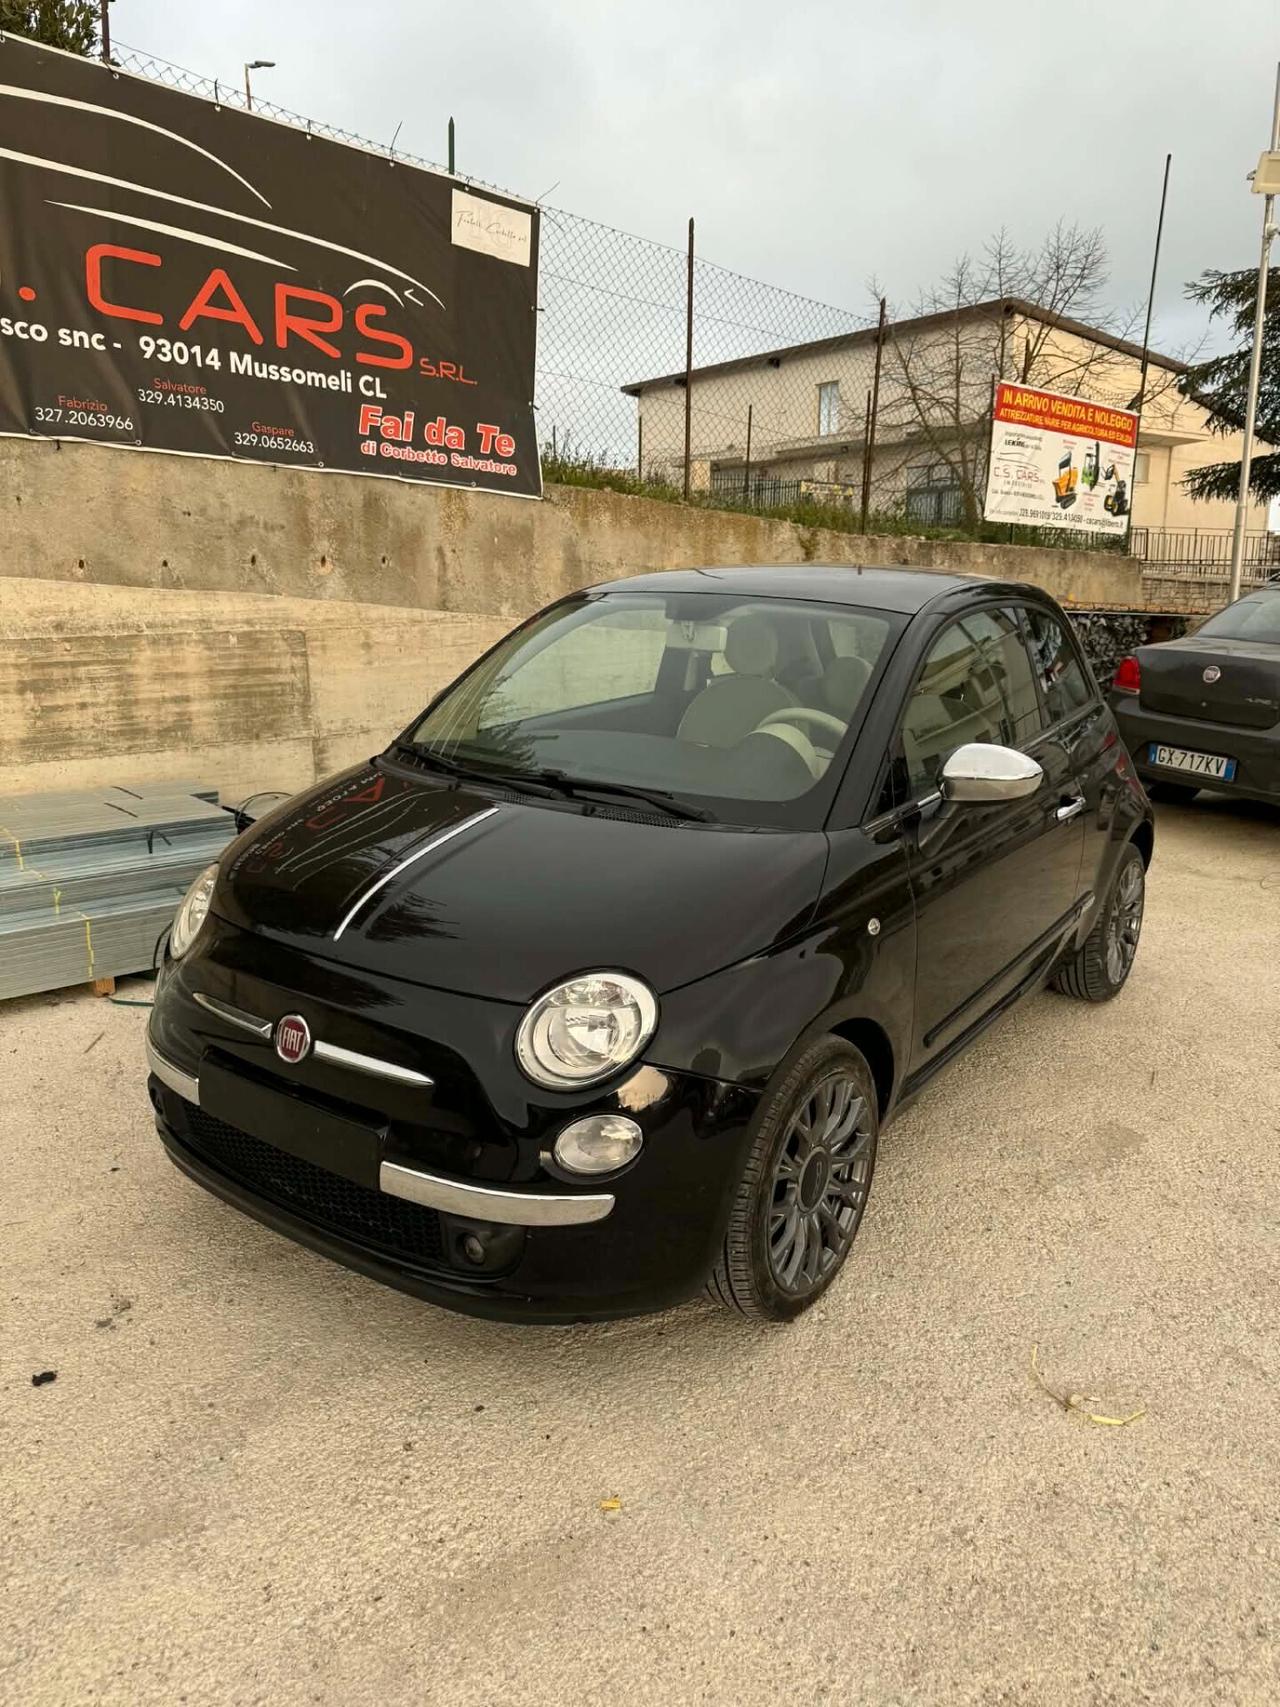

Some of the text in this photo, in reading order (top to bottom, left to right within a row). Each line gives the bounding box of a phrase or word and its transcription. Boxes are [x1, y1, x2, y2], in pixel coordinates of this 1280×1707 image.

[86, 243, 478, 385] CARS S.R.L.
[0, 317, 48, 342] sco
[58, 327, 107, 351] snc
[138, 335, 222, 371] 93014
[229, 351, 352, 393] Mussomeli
[358, 375, 387, 399] CL
[153, 377, 207, 395] Salvatore
[58, 396, 108, 413] Fabrizio
[138, 389, 225, 413] 329.4134350
[1002, 388, 1013, 405] IN
[1014, 391, 1050, 412] ARRIVO
[1051, 399, 1086, 420] VENDITA
[1087, 407, 1094, 422] E
[34, 407, 134, 431] 327.2063966
[251, 421, 295, 438] Gaspare
[358, 404, 515, 457] Fai da Te
[234, 431, 315, 454] 329.0652663
[360, 441, 518, 476] di Corbetto Salvatore
[282, 1026, 304, 1052] FIAT
